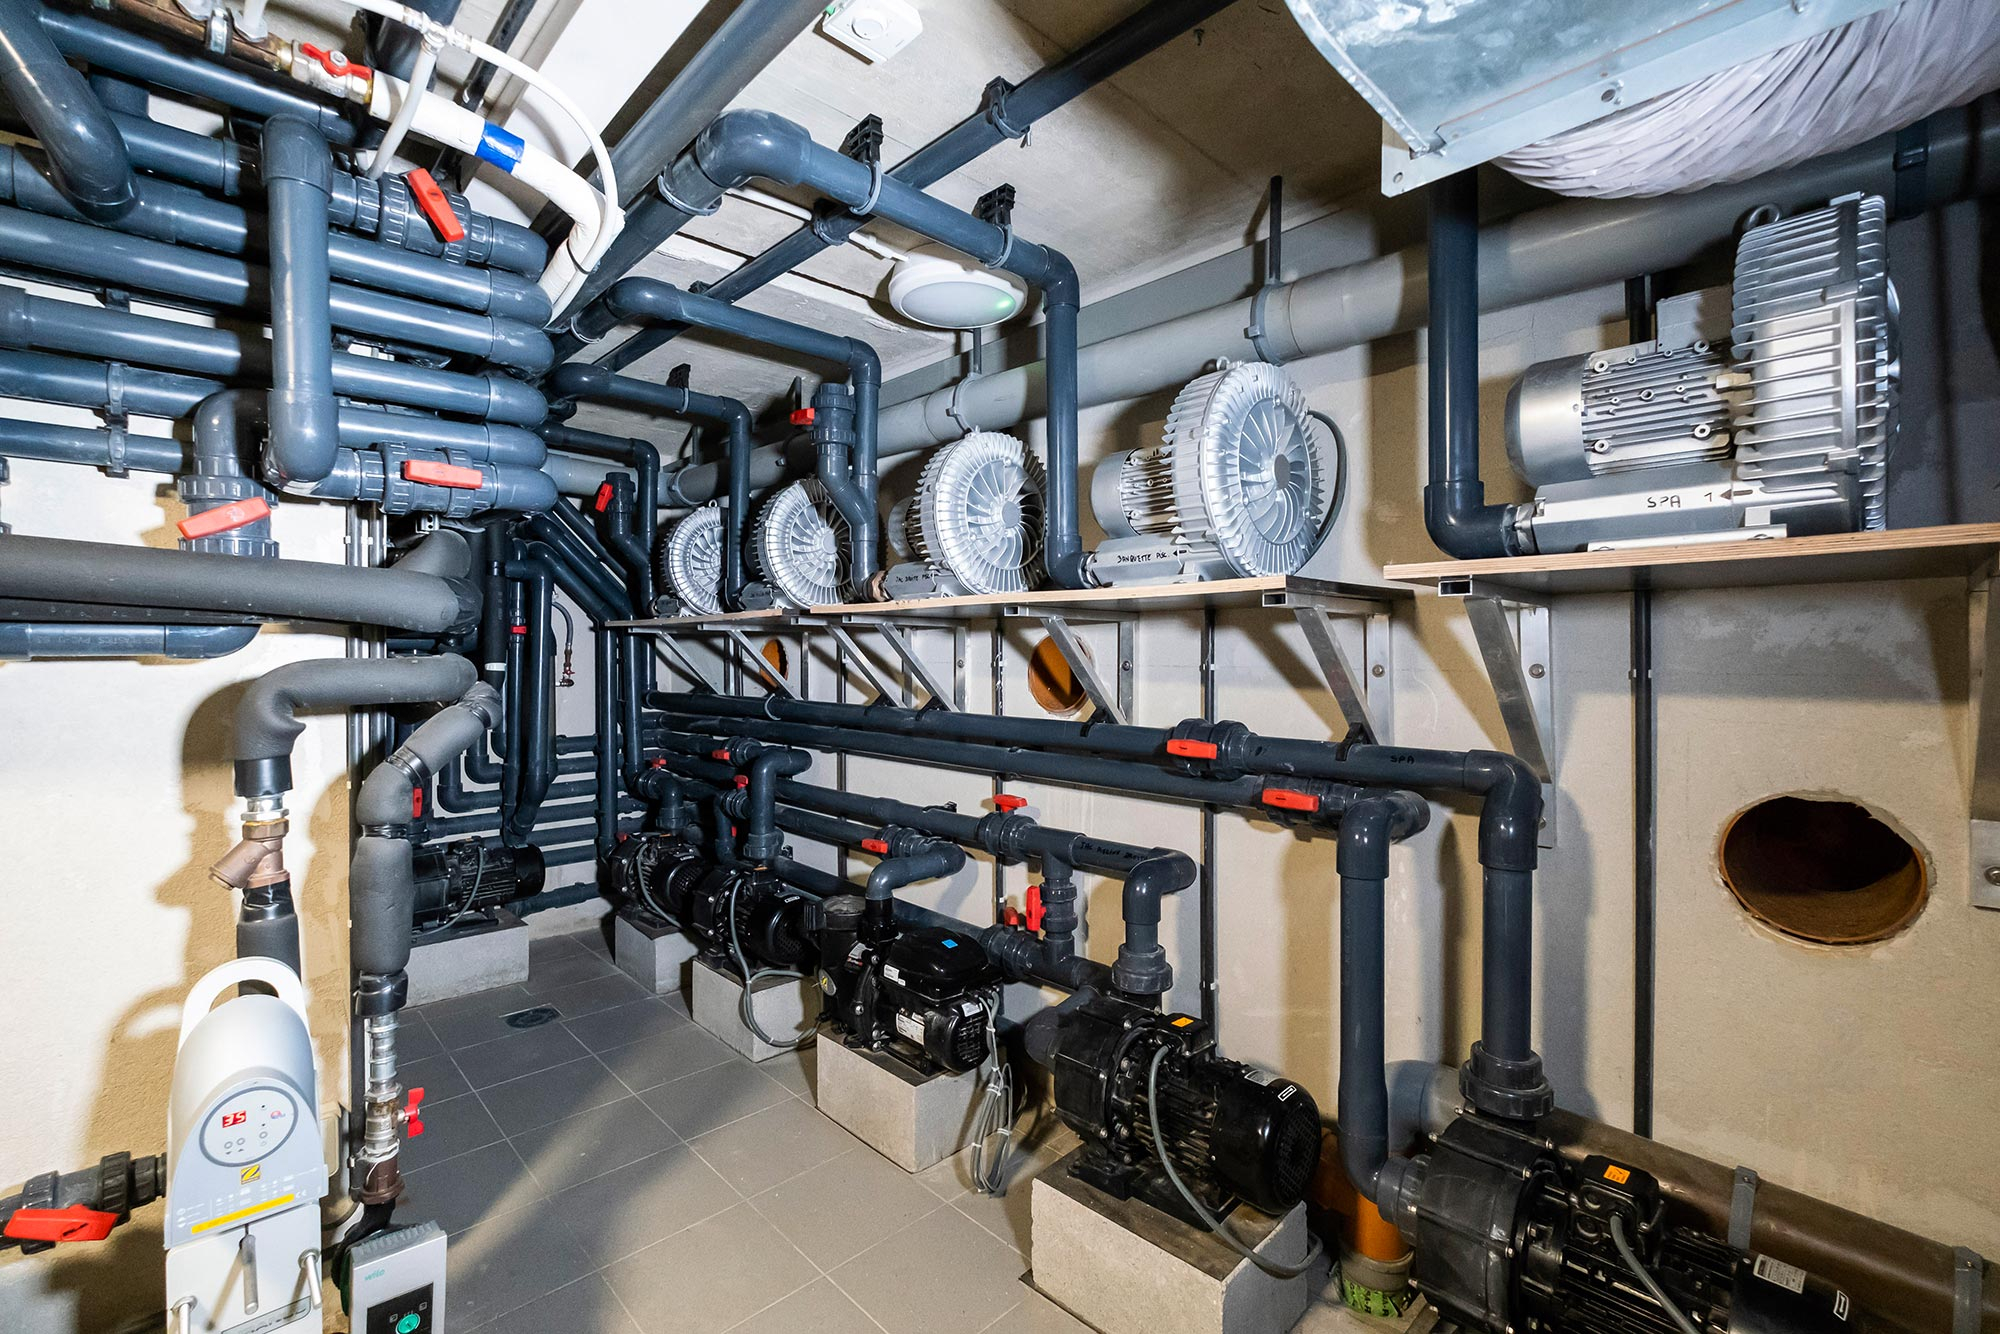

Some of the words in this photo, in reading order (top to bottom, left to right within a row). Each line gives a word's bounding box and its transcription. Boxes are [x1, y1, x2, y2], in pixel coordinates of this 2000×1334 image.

[1647, 495, 1681, 508] SPA
[1390, 755, 1415, 765] SPA
[223, 1110, 247, 1128] 35
